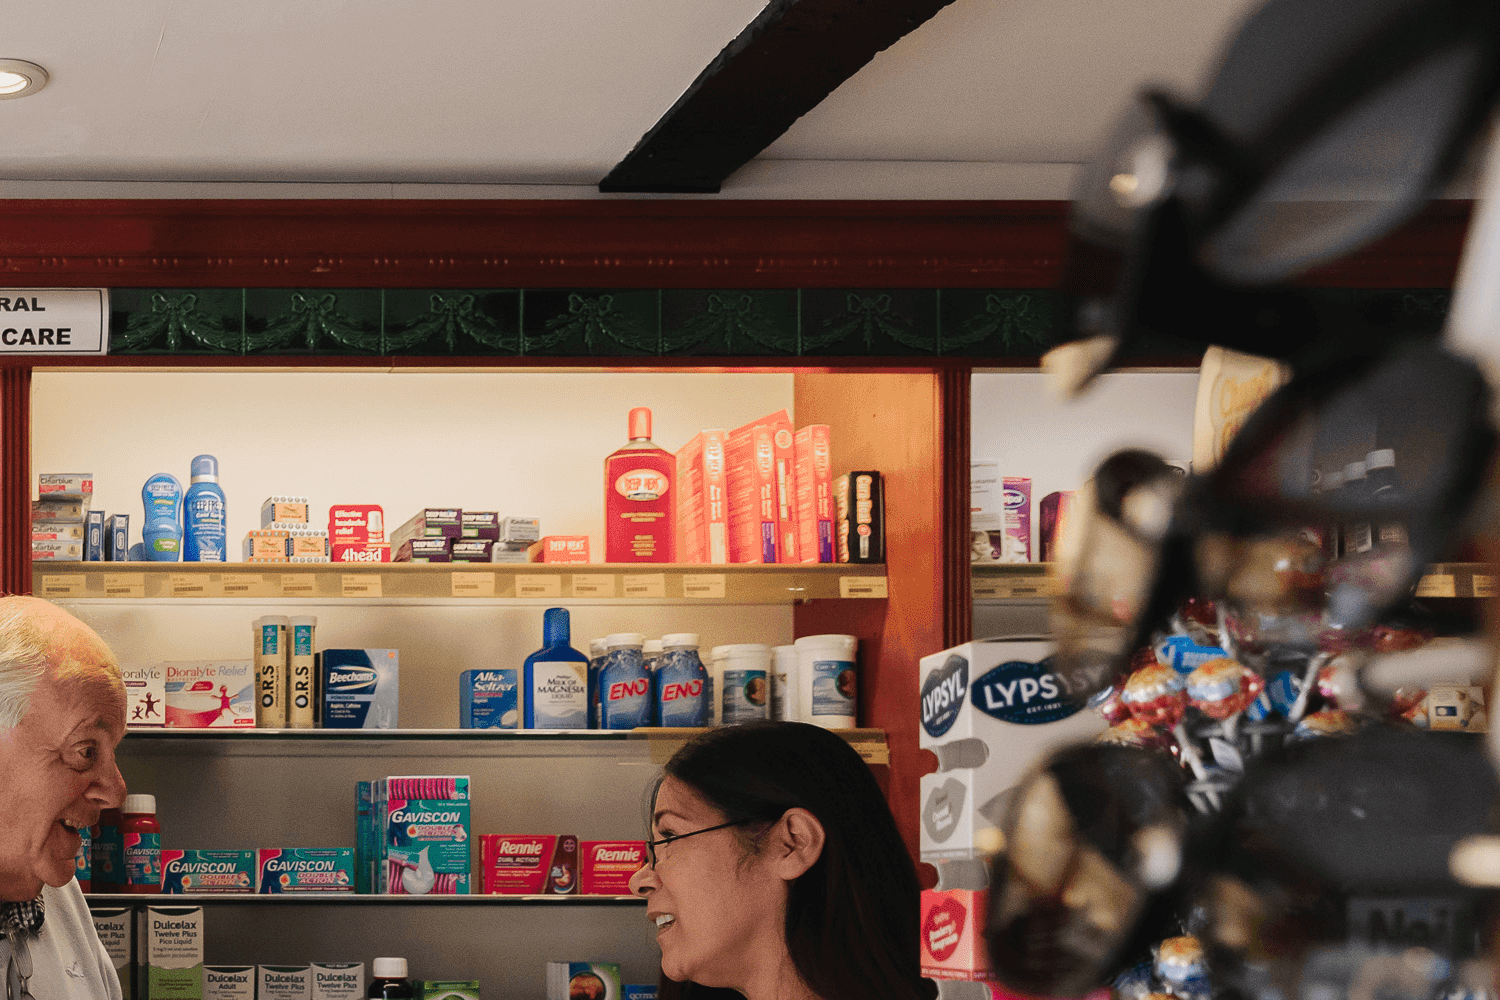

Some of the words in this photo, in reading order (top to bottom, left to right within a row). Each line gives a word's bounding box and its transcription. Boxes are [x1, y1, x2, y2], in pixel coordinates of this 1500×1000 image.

[40, 477, 72, 485] Clearblue
[335, 510, 362, 518] Effective
[341, 548, 382, 562] 4head
[167, 664, 216, 678] Dioralyte
[218, 665, 248, 676] Relief
[329, 671, 373, 684] Beechams
[474, 672, 506, 682] Alka-
[262, 665, 274, 708] O.R.S
[473, 681, 517, 692] Seltzer
[537, 686, 584, 694] MAGNESIA
[609, 680, 648, 700] ENO
[663, 680, 703, 701] ENO
[922, 670, 965, 723] LYPSYL
[500, 841, 543, 855] Rennie
[595, 848, 640, 862] Rennie
[169, 861, 236, 874] GAVISCON
[266, 859, 335, 872] GAVISCON
